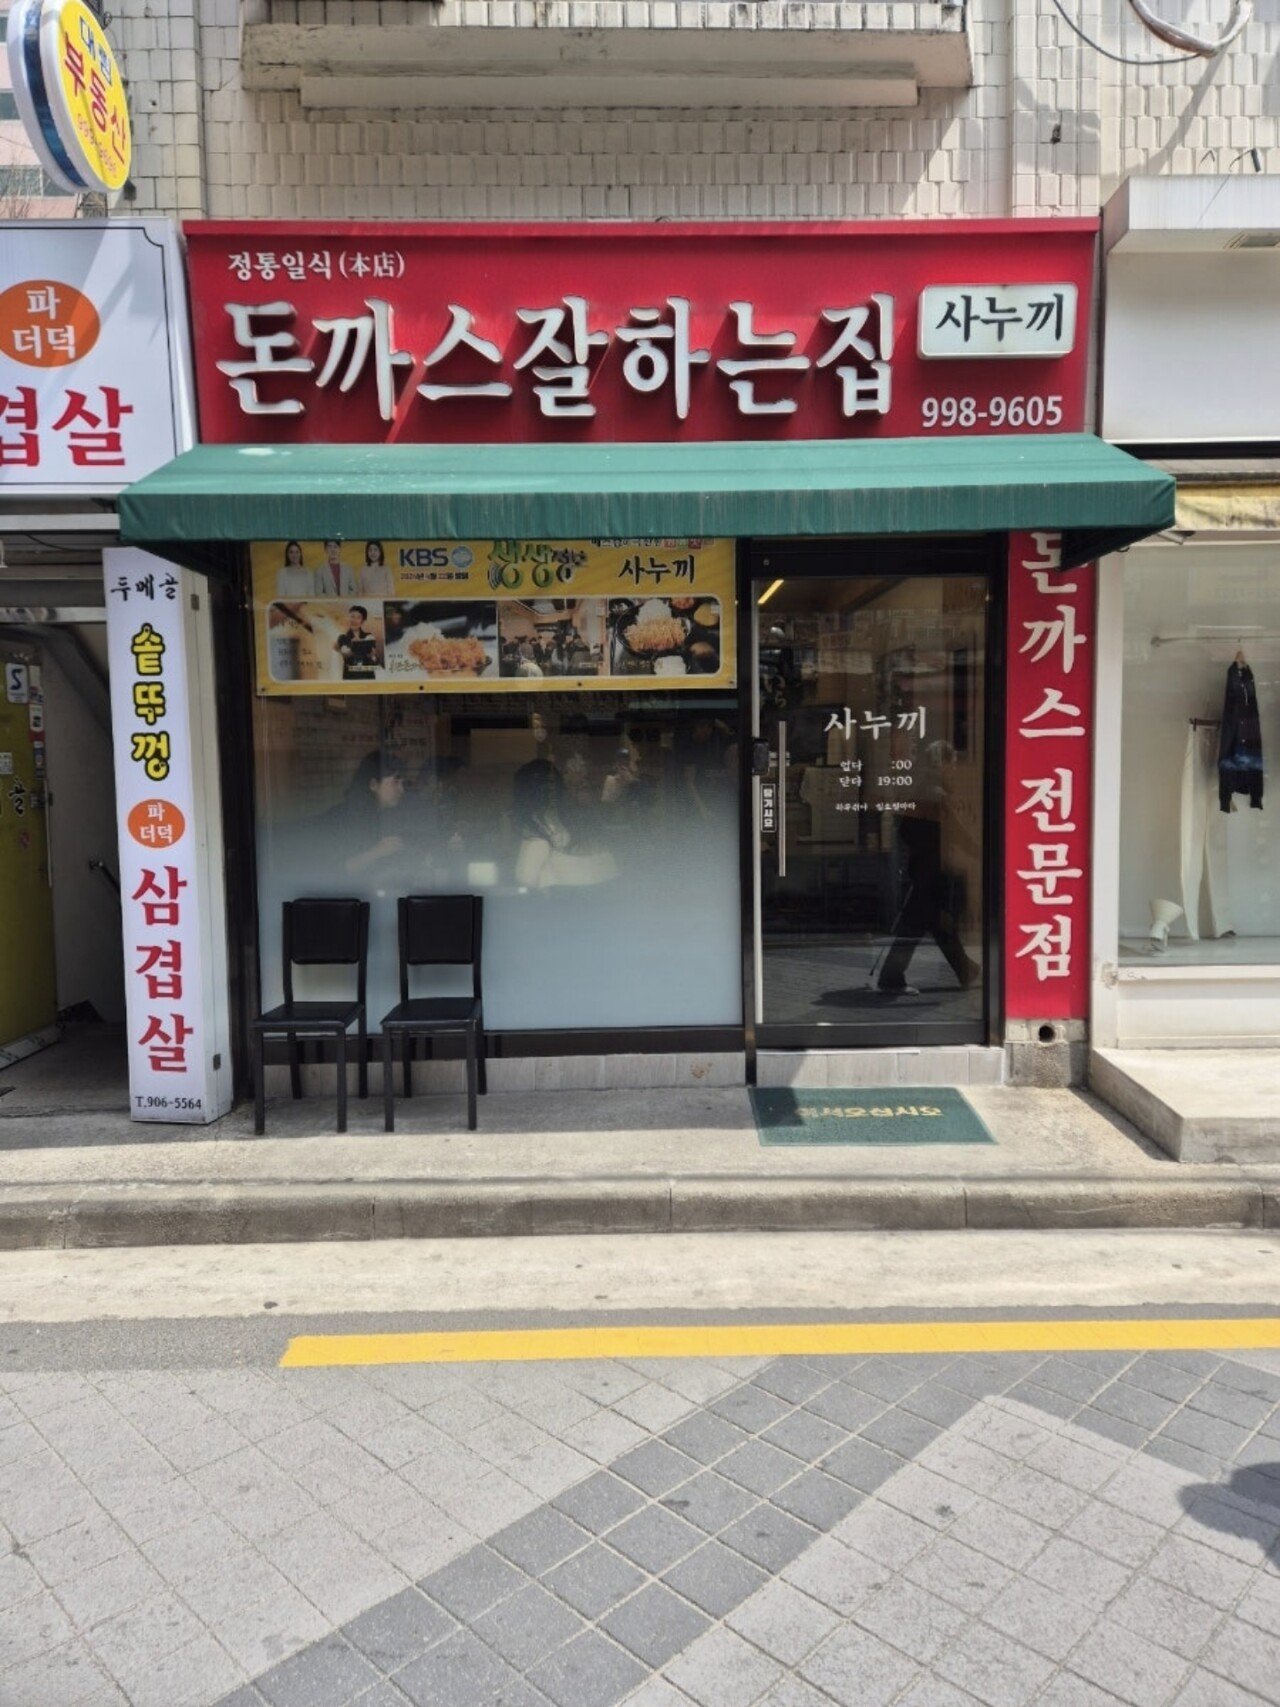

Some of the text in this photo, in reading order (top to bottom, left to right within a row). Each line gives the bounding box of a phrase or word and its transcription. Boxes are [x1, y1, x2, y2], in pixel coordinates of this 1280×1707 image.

[64, 32, 126, 165] 부동산
[26, 285, 61, 320] 파
[935, 293, 1063, 342] 사누끼
[12, 324, 76, 359] 더덕
[921, 395, 1063, 428] 998-9605
[400, 548, 449, 567] KBS
[618, 554, 695, 584] 사누끼
[131, 622, 170, 781] 솥뚜껑
[824, 706, 926, 740] 사누끼
[877, 776, 913, 786] 19:00
[147, 802, 165, 822] 파
[140, 823, 173, 845] 더덕
[132, 866, 194, 1073] 삼겹살
[135, 1096, 202, 1110] T.906-5564
